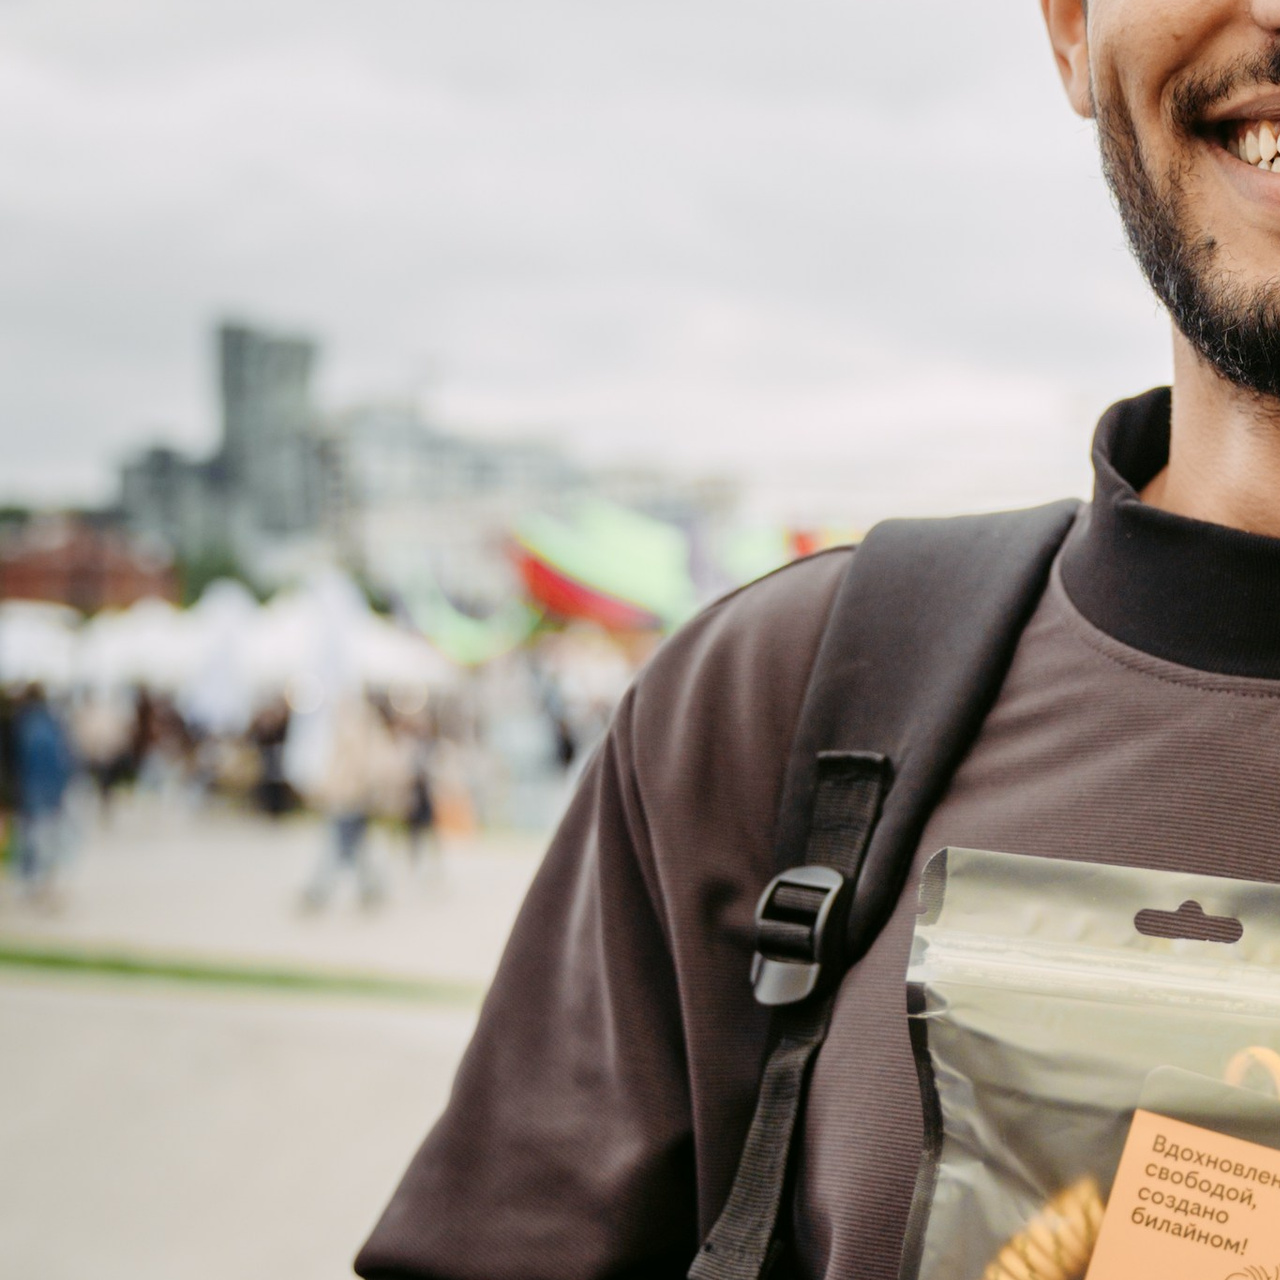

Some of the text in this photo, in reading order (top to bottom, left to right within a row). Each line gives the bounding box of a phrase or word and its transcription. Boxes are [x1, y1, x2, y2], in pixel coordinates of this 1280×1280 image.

[1138, 1187, 1229, 1224] создано
[1145, 1163, 1257, 1210] свободой,
[1131, 1206, 1248, 1255] билайном!
